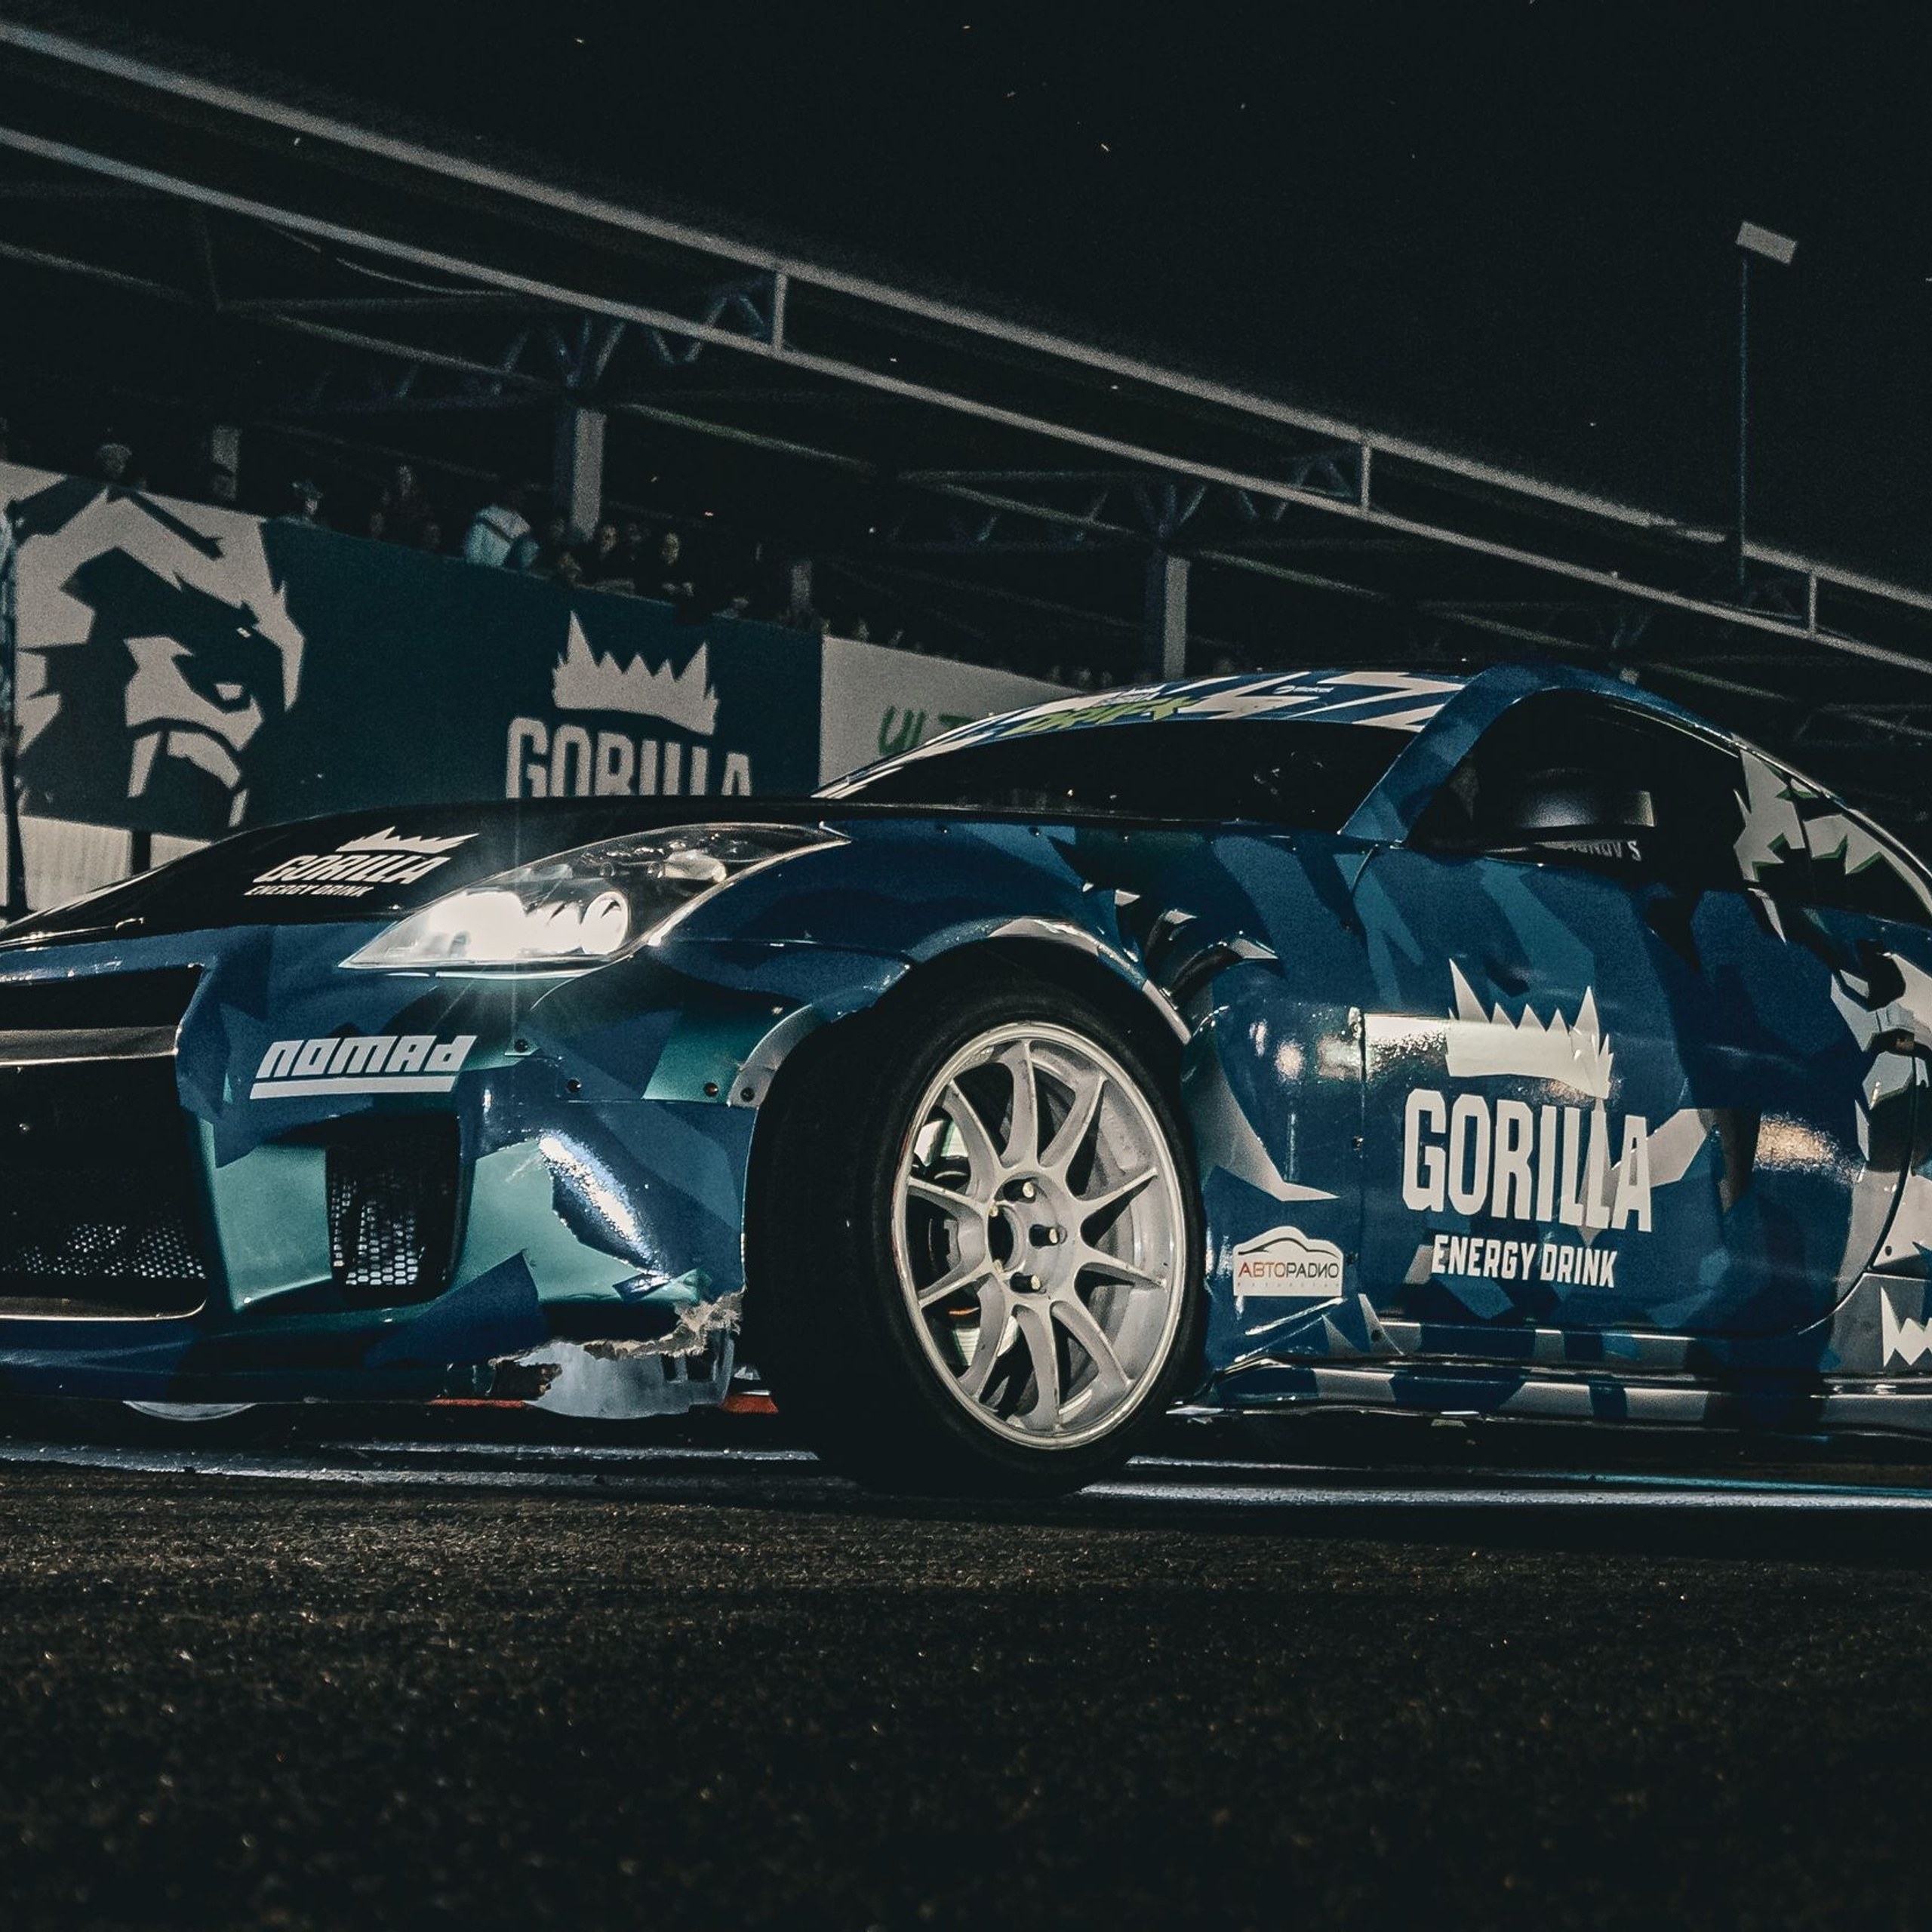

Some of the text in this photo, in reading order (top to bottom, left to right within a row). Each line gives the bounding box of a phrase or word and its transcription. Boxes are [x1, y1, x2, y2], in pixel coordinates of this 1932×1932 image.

[252, 854, 451, 884] GORILLA
[243, 884, 374, 897] ENERGY DRINK
[1402, 1088, 1652, 1232] GORILLA
[1432, 1235, 1618, 1288] ENERGY DRINK
